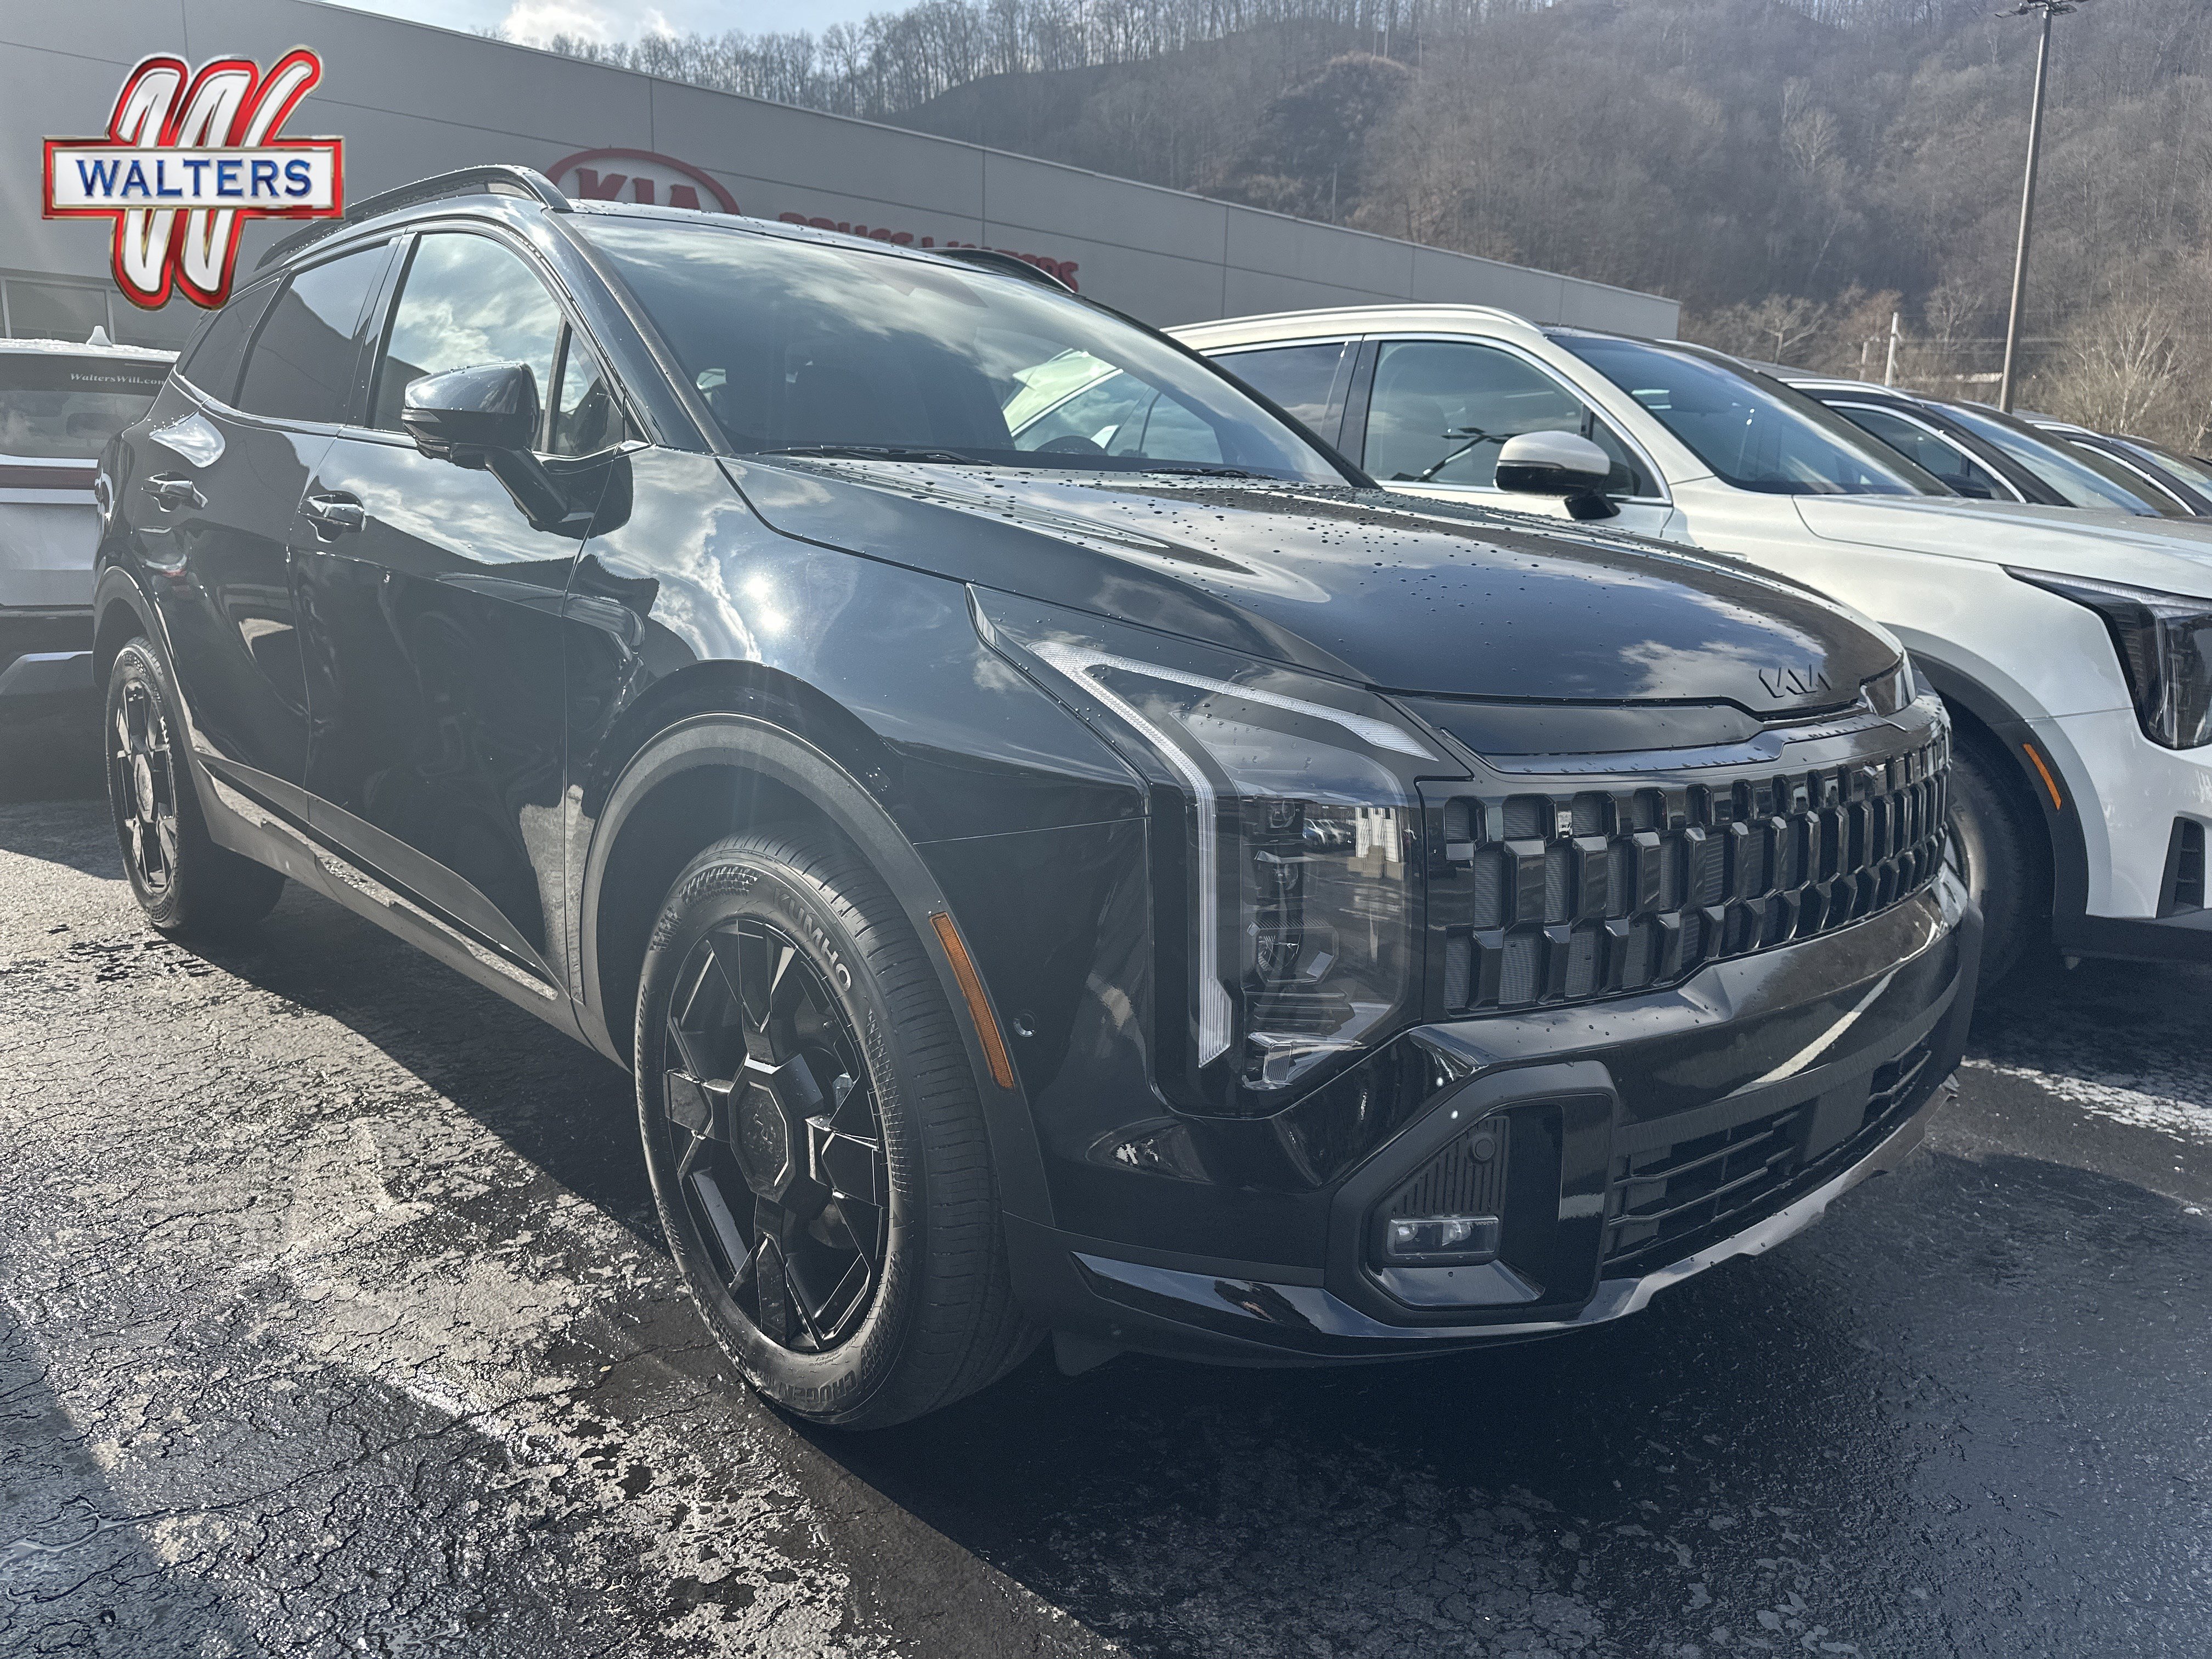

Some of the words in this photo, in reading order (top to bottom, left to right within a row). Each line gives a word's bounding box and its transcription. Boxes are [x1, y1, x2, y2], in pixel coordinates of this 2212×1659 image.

[575, 167, 702, 211] KIA
[773, 887, 852, 992] KUMHO
[638, 983, 648, 1029] 101H
